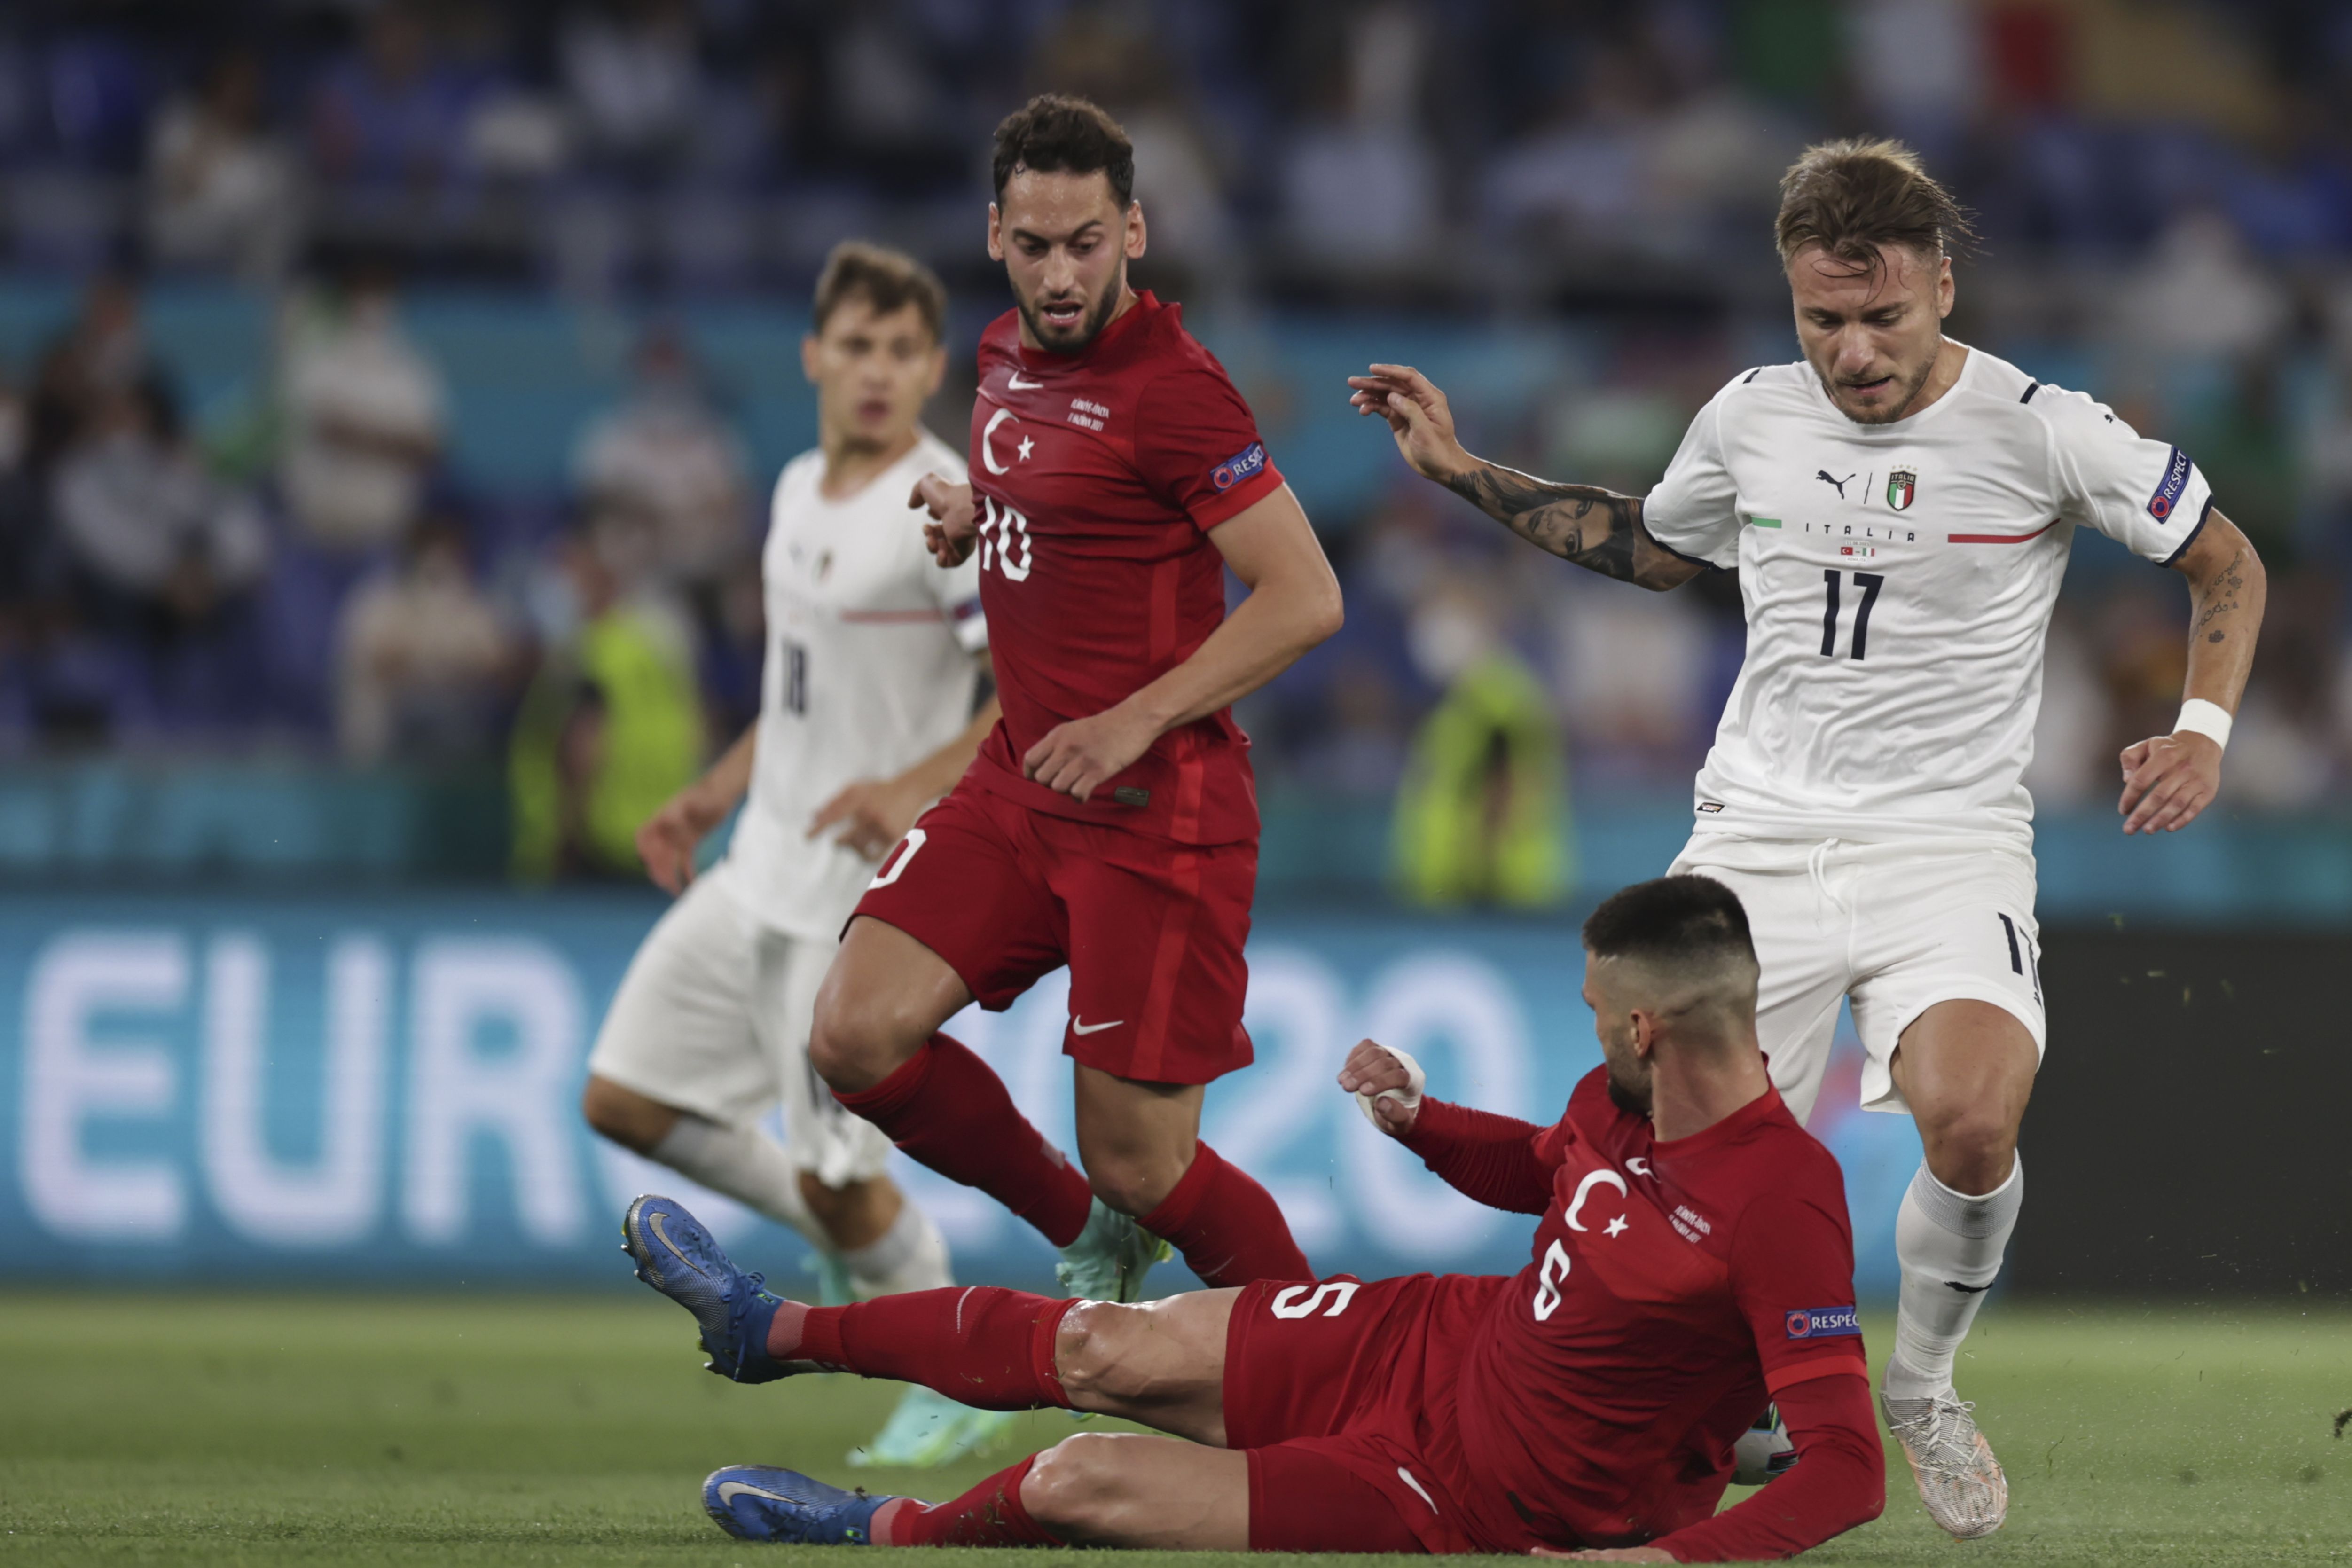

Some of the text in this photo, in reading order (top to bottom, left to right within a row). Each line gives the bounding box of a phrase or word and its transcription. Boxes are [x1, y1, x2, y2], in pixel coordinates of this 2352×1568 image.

[1891, 473, 1914, 482] ITALIA
[2163, 450, 2187, 499] RESPECT
[979, 494, 1032, 582] 10
[1806, 523, 1915, 542] ITALIA
[1820, 569, 1885, 661] 17
[1811, 1314, 1860, 1329] RESPEC
